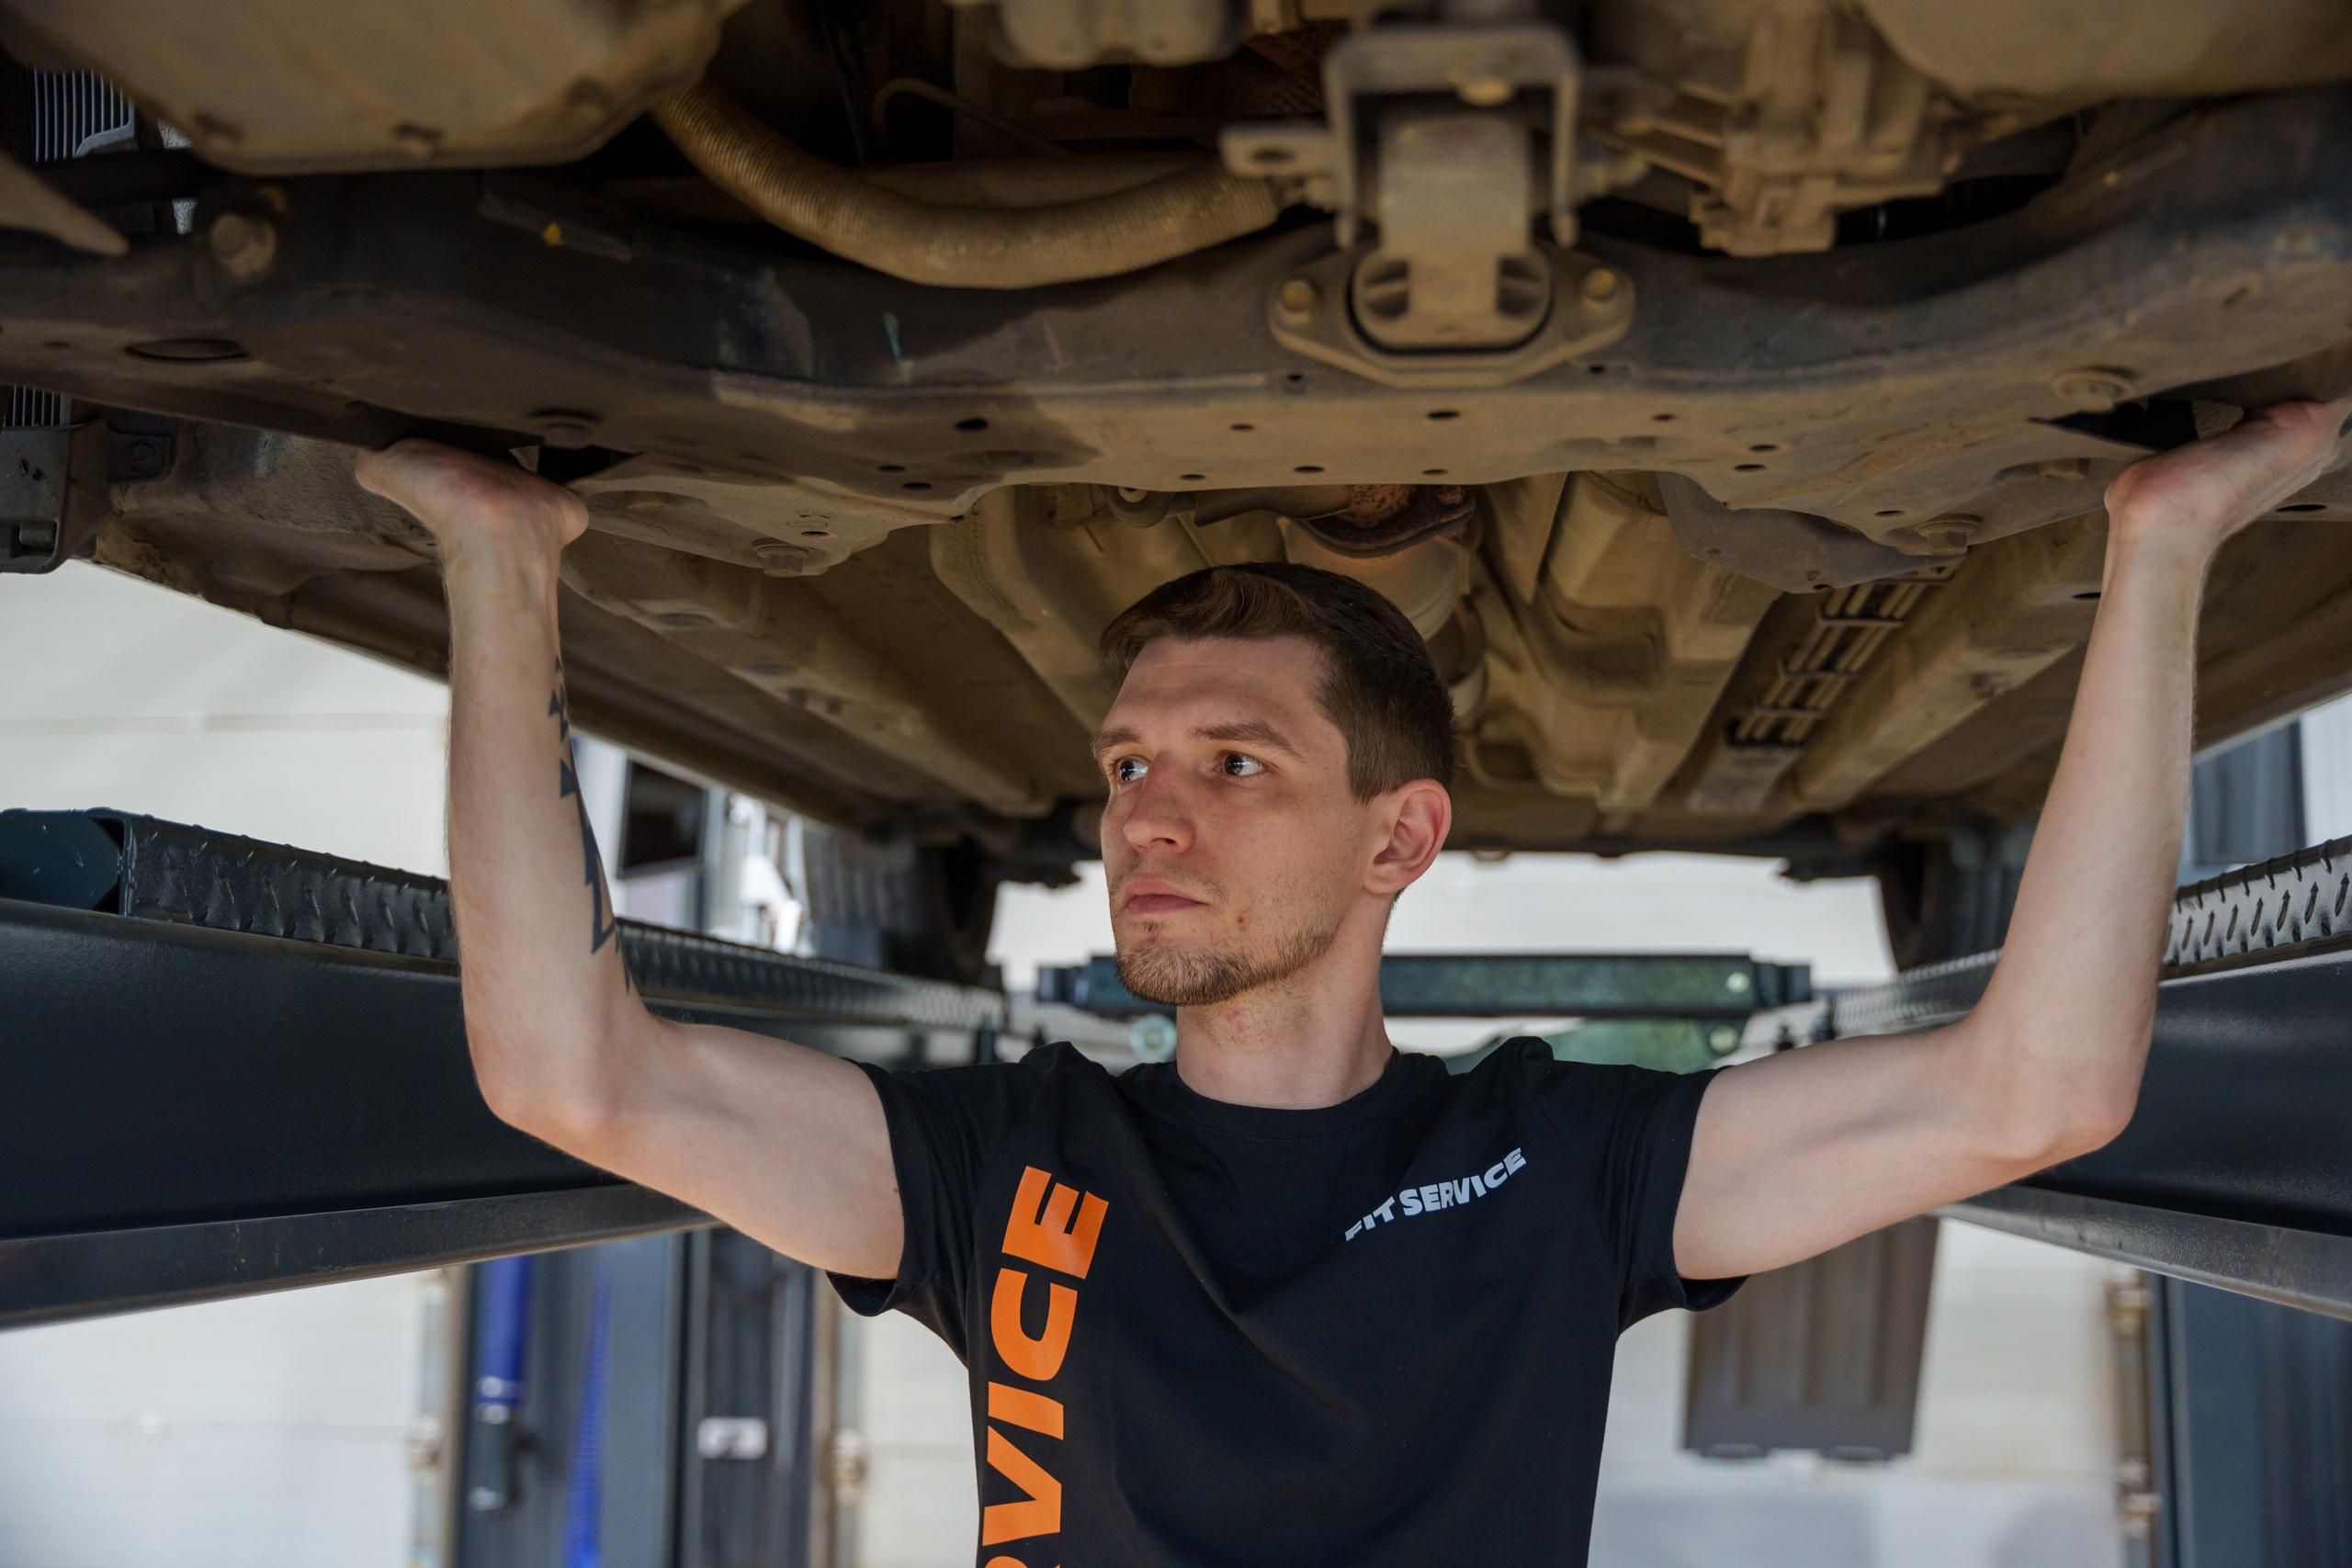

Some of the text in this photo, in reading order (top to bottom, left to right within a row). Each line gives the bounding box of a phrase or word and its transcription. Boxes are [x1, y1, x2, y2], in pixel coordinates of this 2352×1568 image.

[1344, 1146, 1527, 1241] FIT SERVICE
[981, 1165, 1110, 1568] VICE
